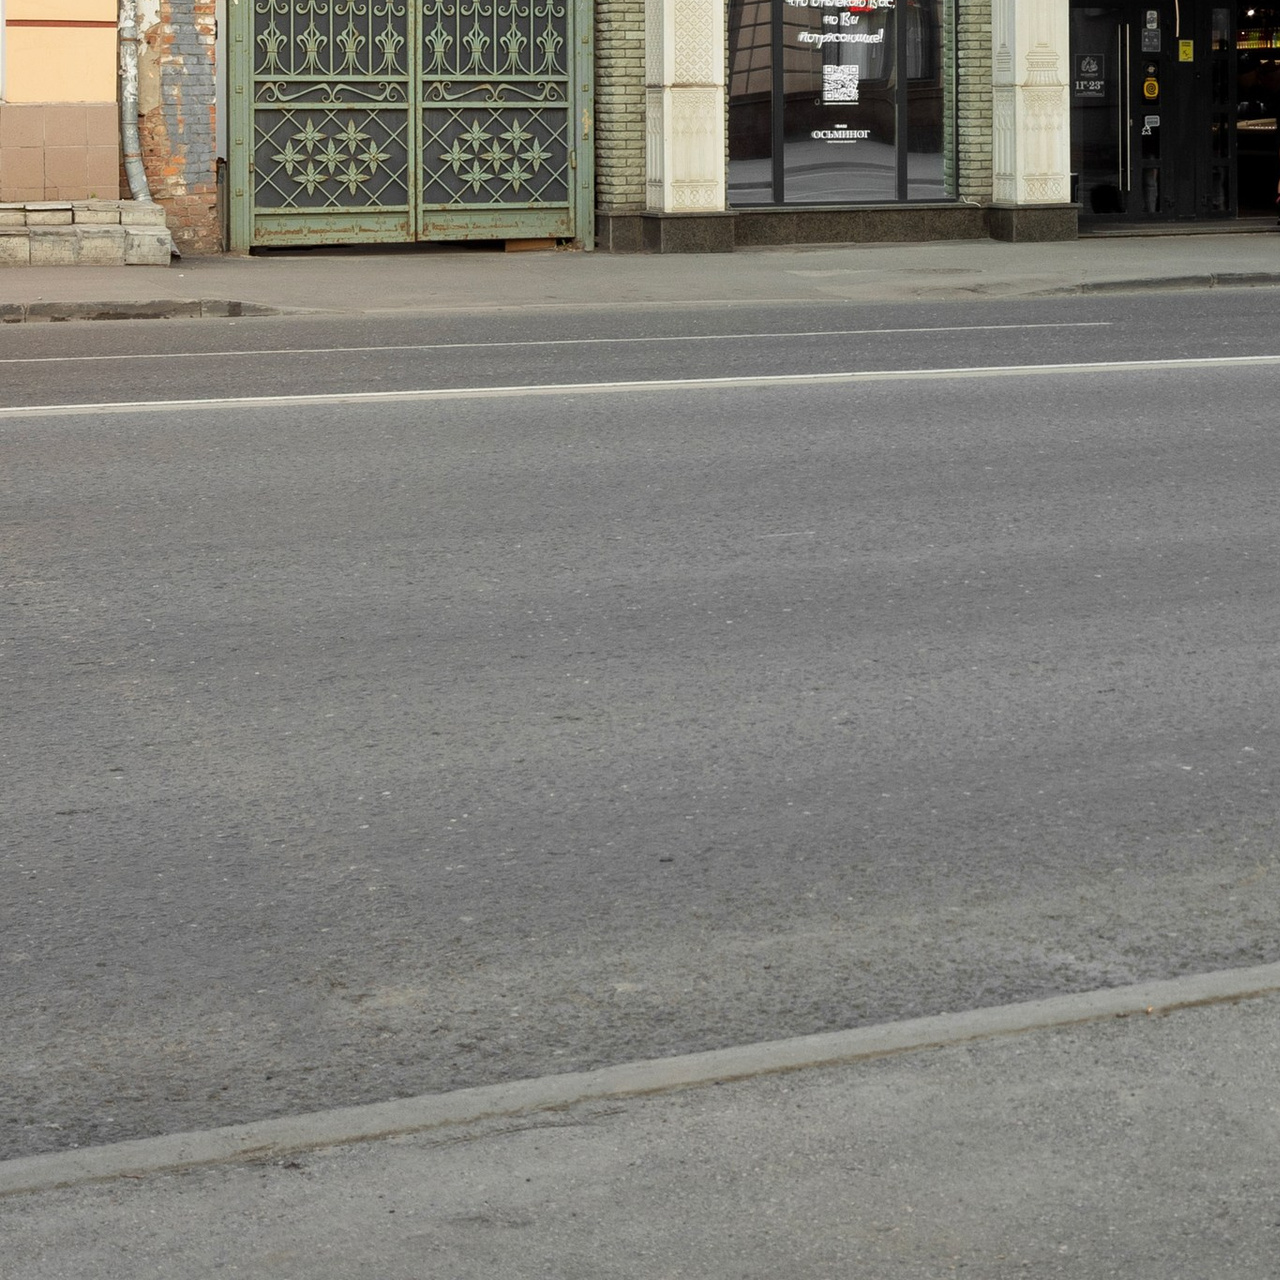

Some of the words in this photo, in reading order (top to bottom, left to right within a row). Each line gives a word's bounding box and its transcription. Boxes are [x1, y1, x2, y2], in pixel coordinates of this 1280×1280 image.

[823, 15, 838, 25] но
[840, 12, 859, 26] Вы
[811, 130, 870, 138] ОСЬМИНОГ
